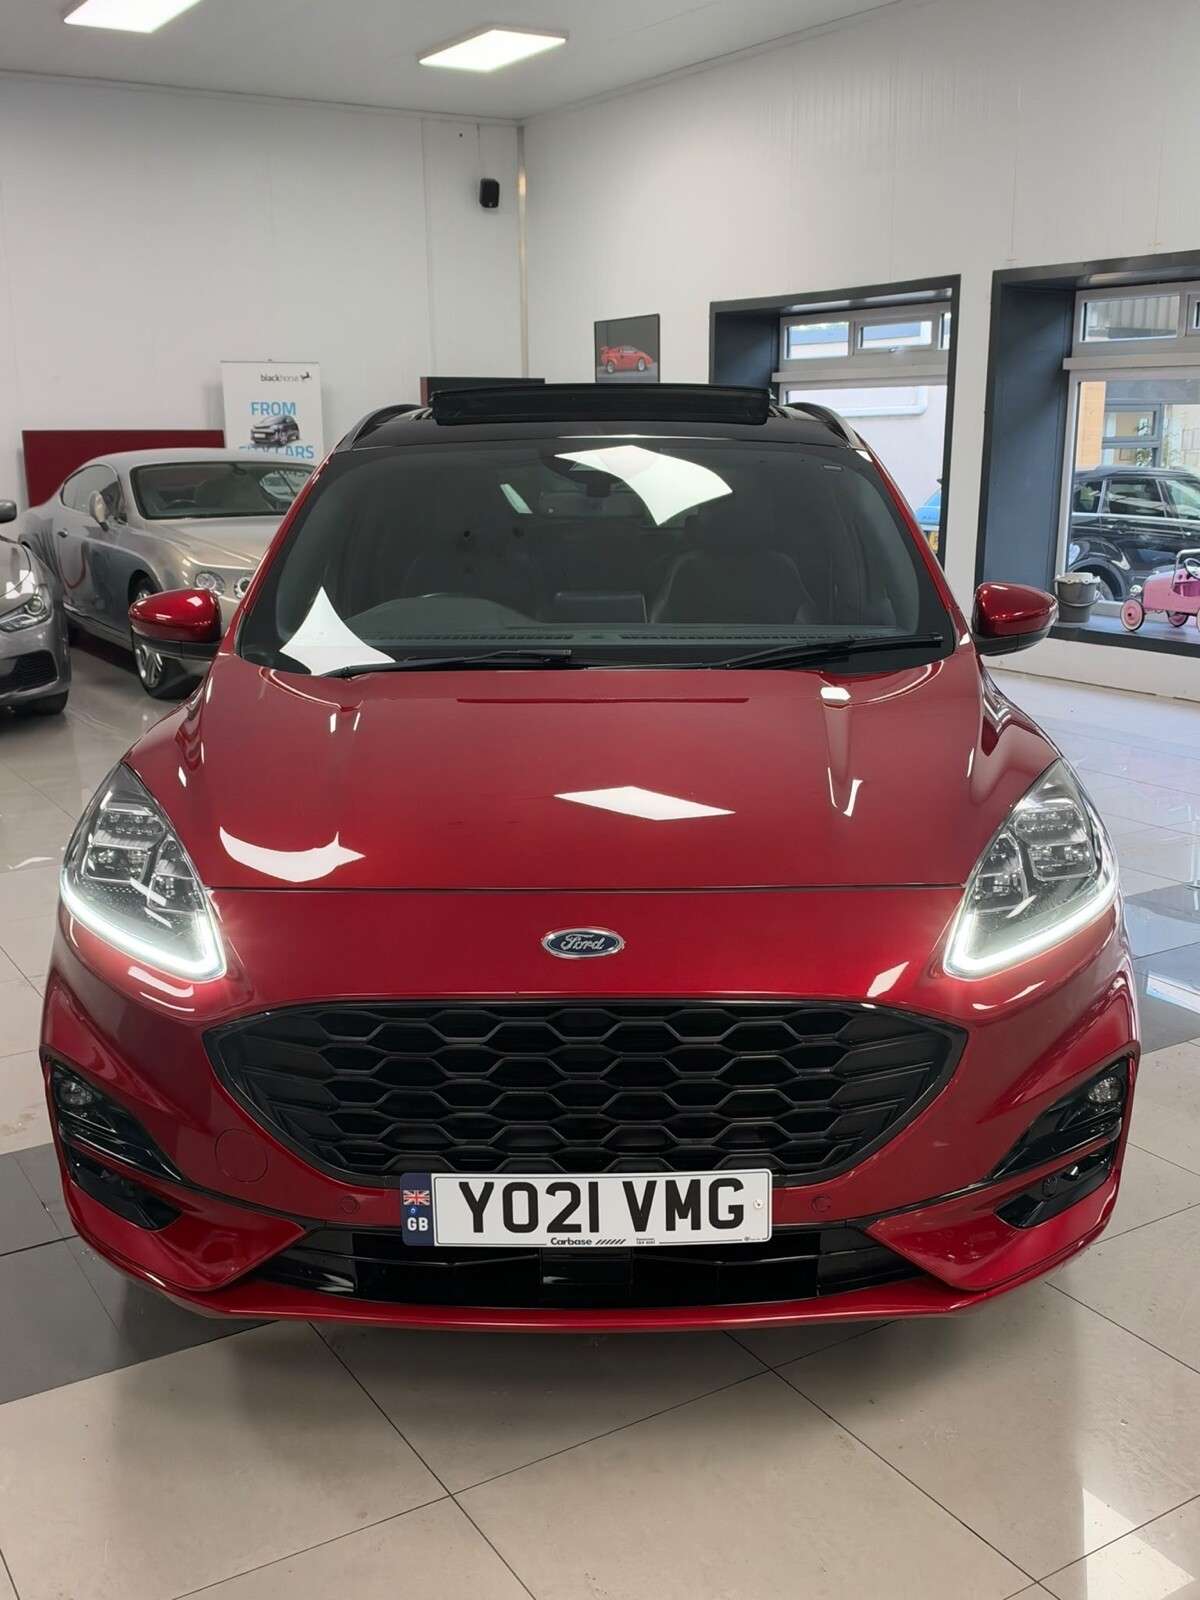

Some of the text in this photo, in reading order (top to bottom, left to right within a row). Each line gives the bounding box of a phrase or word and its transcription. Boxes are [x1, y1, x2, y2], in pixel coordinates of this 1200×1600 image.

[250, 402, 297, 416] FROM
[560, 934, 606, 951] Ford
[458, 1177, 745, 1234] YO21 VMG
[406, 1217, 429, 1232] GB
[550, 1237, 593, 1246] Carbase
